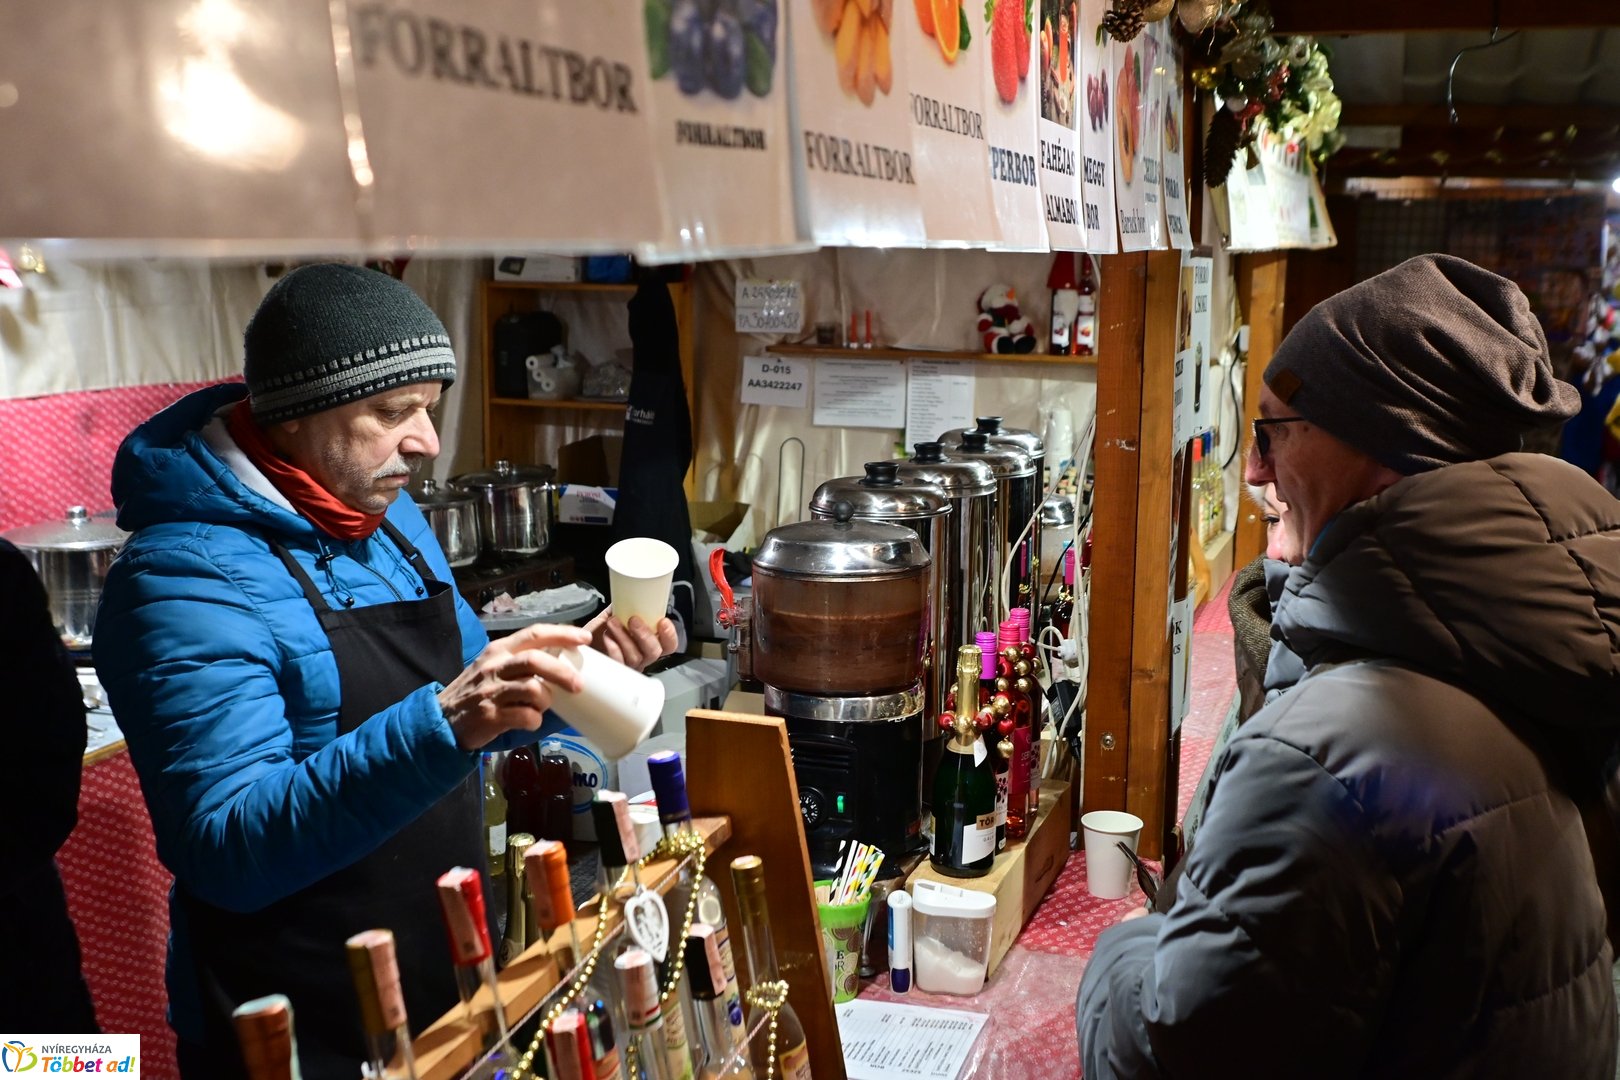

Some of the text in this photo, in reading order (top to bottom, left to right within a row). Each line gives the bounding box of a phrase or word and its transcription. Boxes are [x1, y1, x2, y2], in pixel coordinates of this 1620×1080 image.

[354, 6, 640, 114] FORRALTBOR
[910, 93, 984, 140] ORRALTBOR
[675, 120, 767, 151] FORRALTBOR
[804, 130, 916, 185] FORRALTBOR
[988, 144, 1037, 188] PERBOR
[1040, 138, 1076, 177] FAHÉJAS
[1083, 155, 1106, 188] MEGGY
[1086, 202, 1101, 230] BOR
[747, 378, 803, 391] AA3422247
[762, 363, 792, 375] D-015
